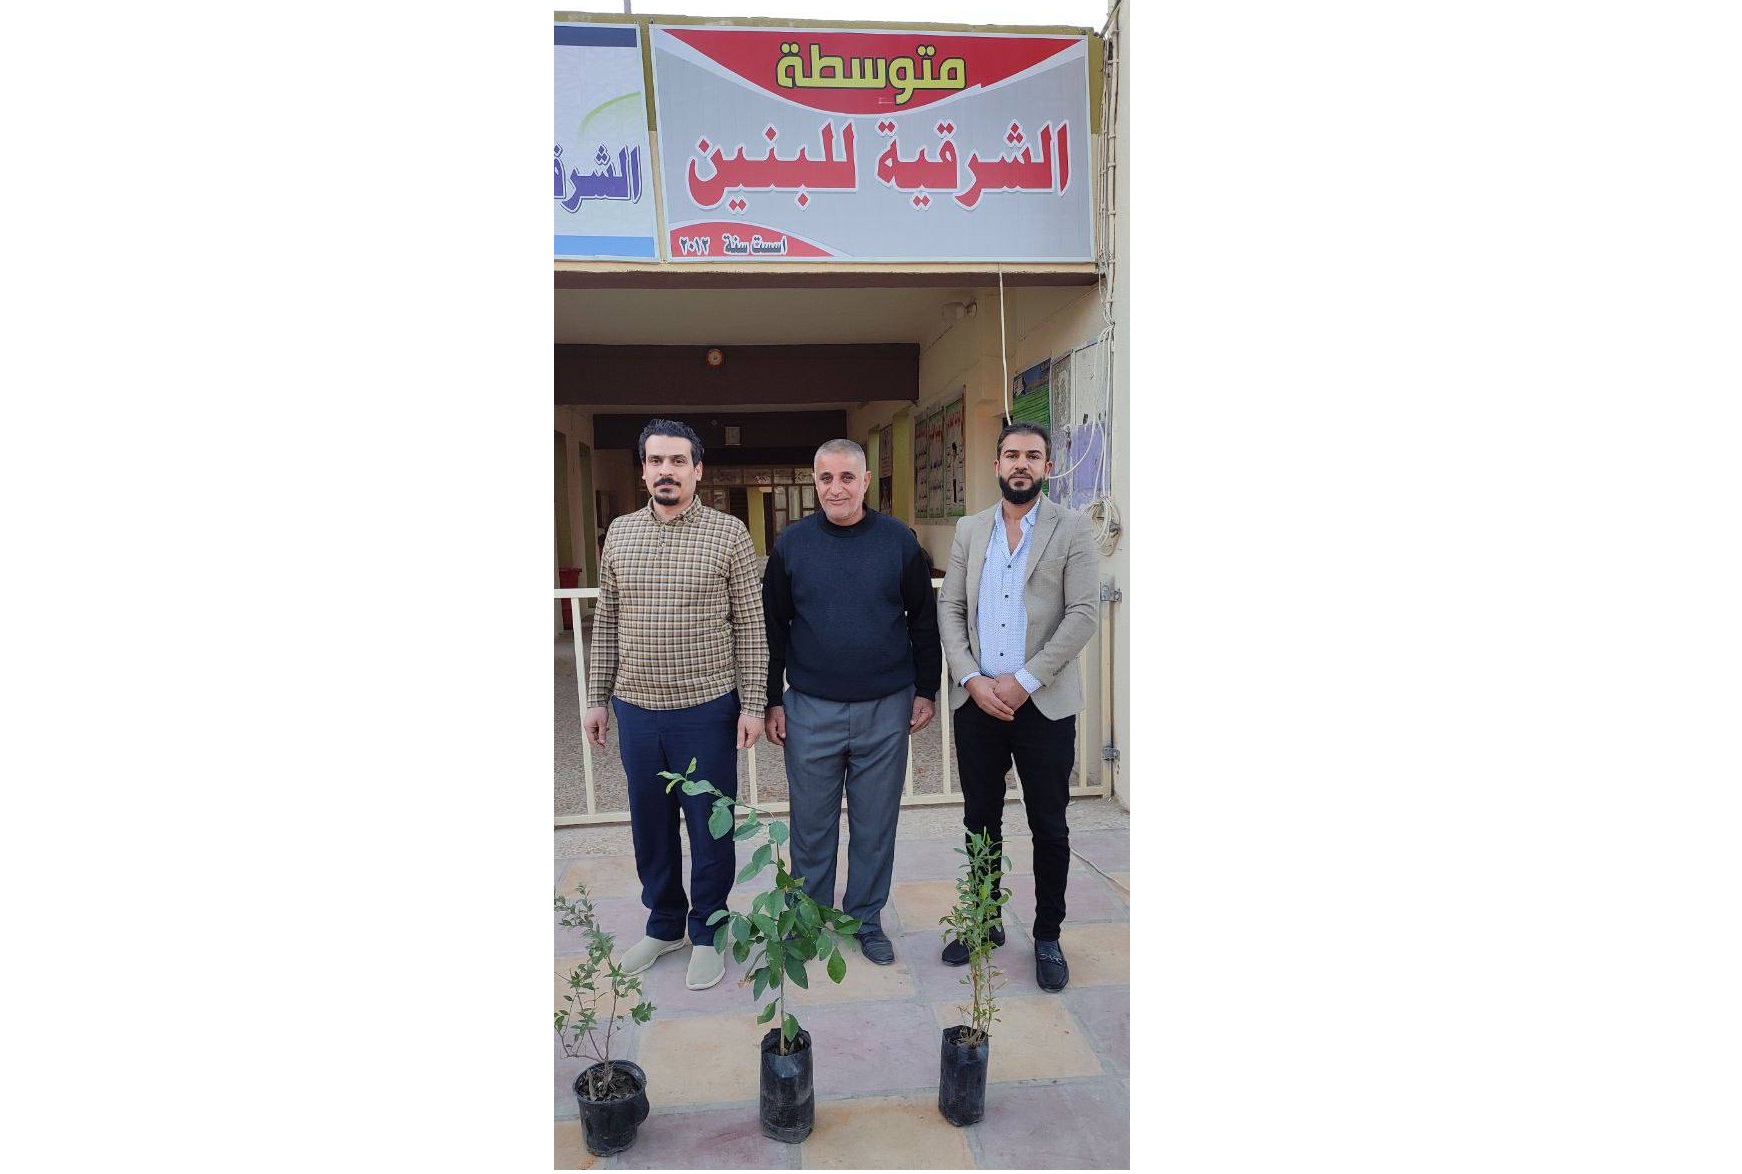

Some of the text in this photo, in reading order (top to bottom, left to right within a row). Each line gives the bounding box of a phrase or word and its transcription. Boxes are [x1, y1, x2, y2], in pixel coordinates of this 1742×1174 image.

[776, 42, 967, 105] متوسطة
[686, 119, 1069, 211] الشرقية للبنين
[722, 233, 750, 255] سنة
